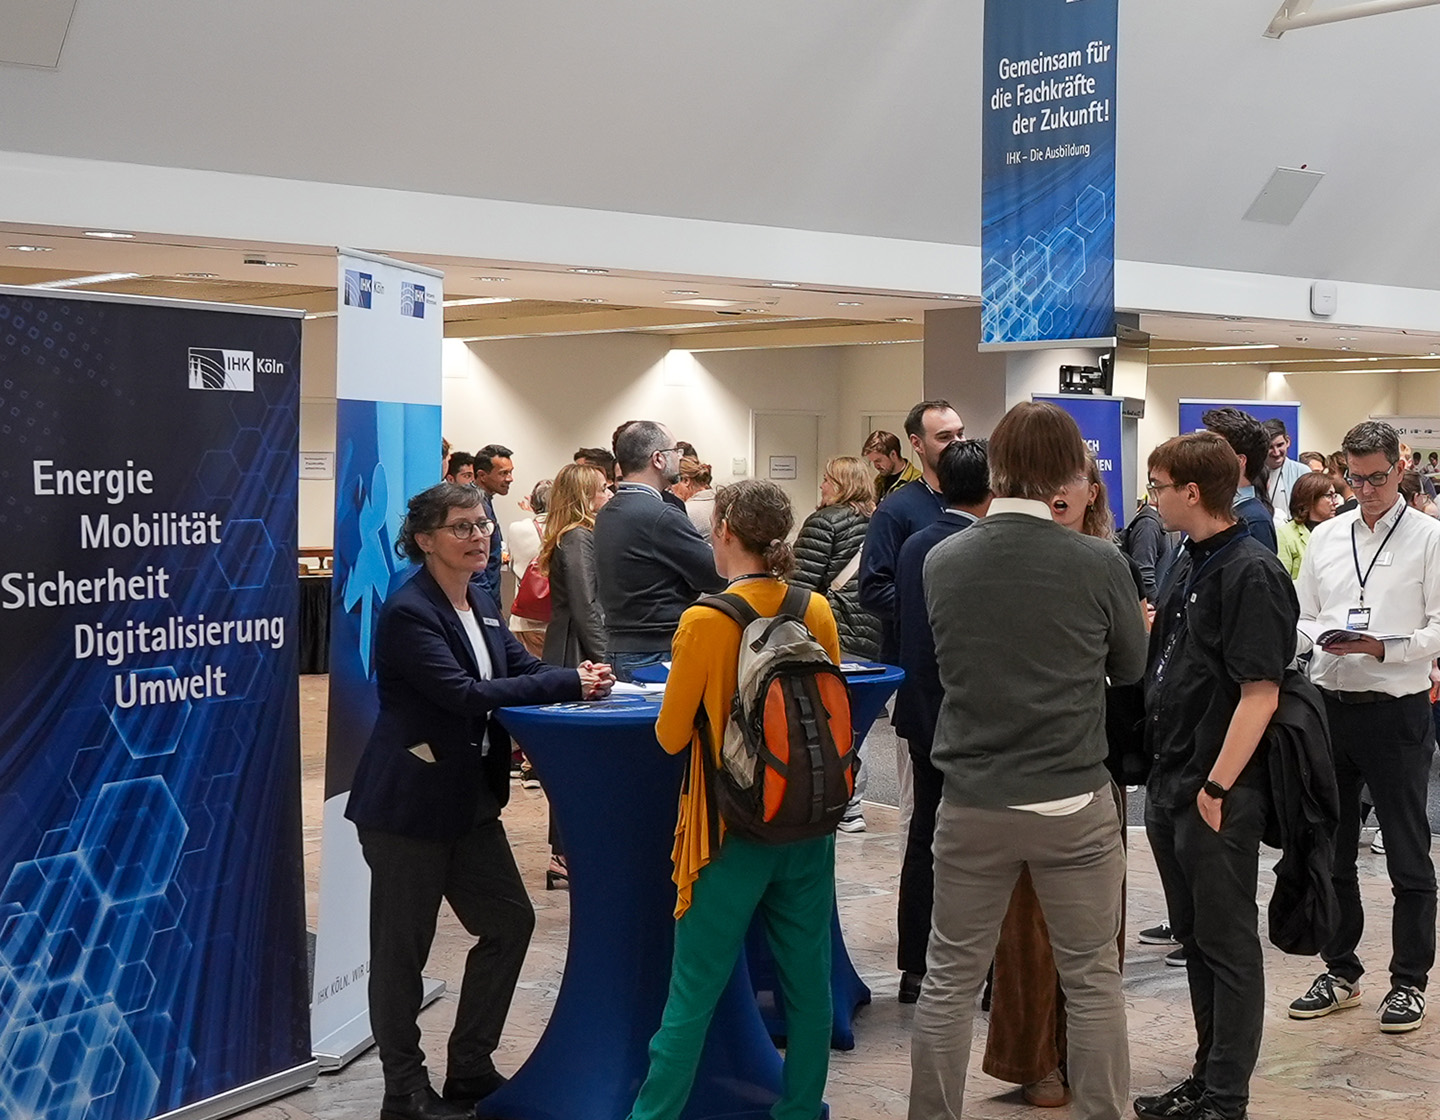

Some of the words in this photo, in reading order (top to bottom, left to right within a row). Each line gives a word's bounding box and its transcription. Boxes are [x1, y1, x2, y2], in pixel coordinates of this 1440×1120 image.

[999, 51, 1083, 81] Gemeinsam
[1085, 40, 1111, 64] für
[991, 87, 1013, 110] die
[1016, 73, 1096, 106] Fachkräfte
[1012, 113, 1037, 136] der
[1040, 98, 1110, 131] Zukunft!
[1006, 151, 1021, 165] IHK
[1030, 148, 1044, 162] Die
[1045, 143, 1091, 162] Ausbildung
[227, 356, 251, 372] IHK
[256, 357, 284, 374] Köln
[32, 460, 154, 504] Energie
[80, 511, 222, 550] Mobilität
[1, 565, 170, 610] Sicherheit
[74, 614, 285, 666] Digitalisierung
[114, 664, 227, 709] Umwelt
